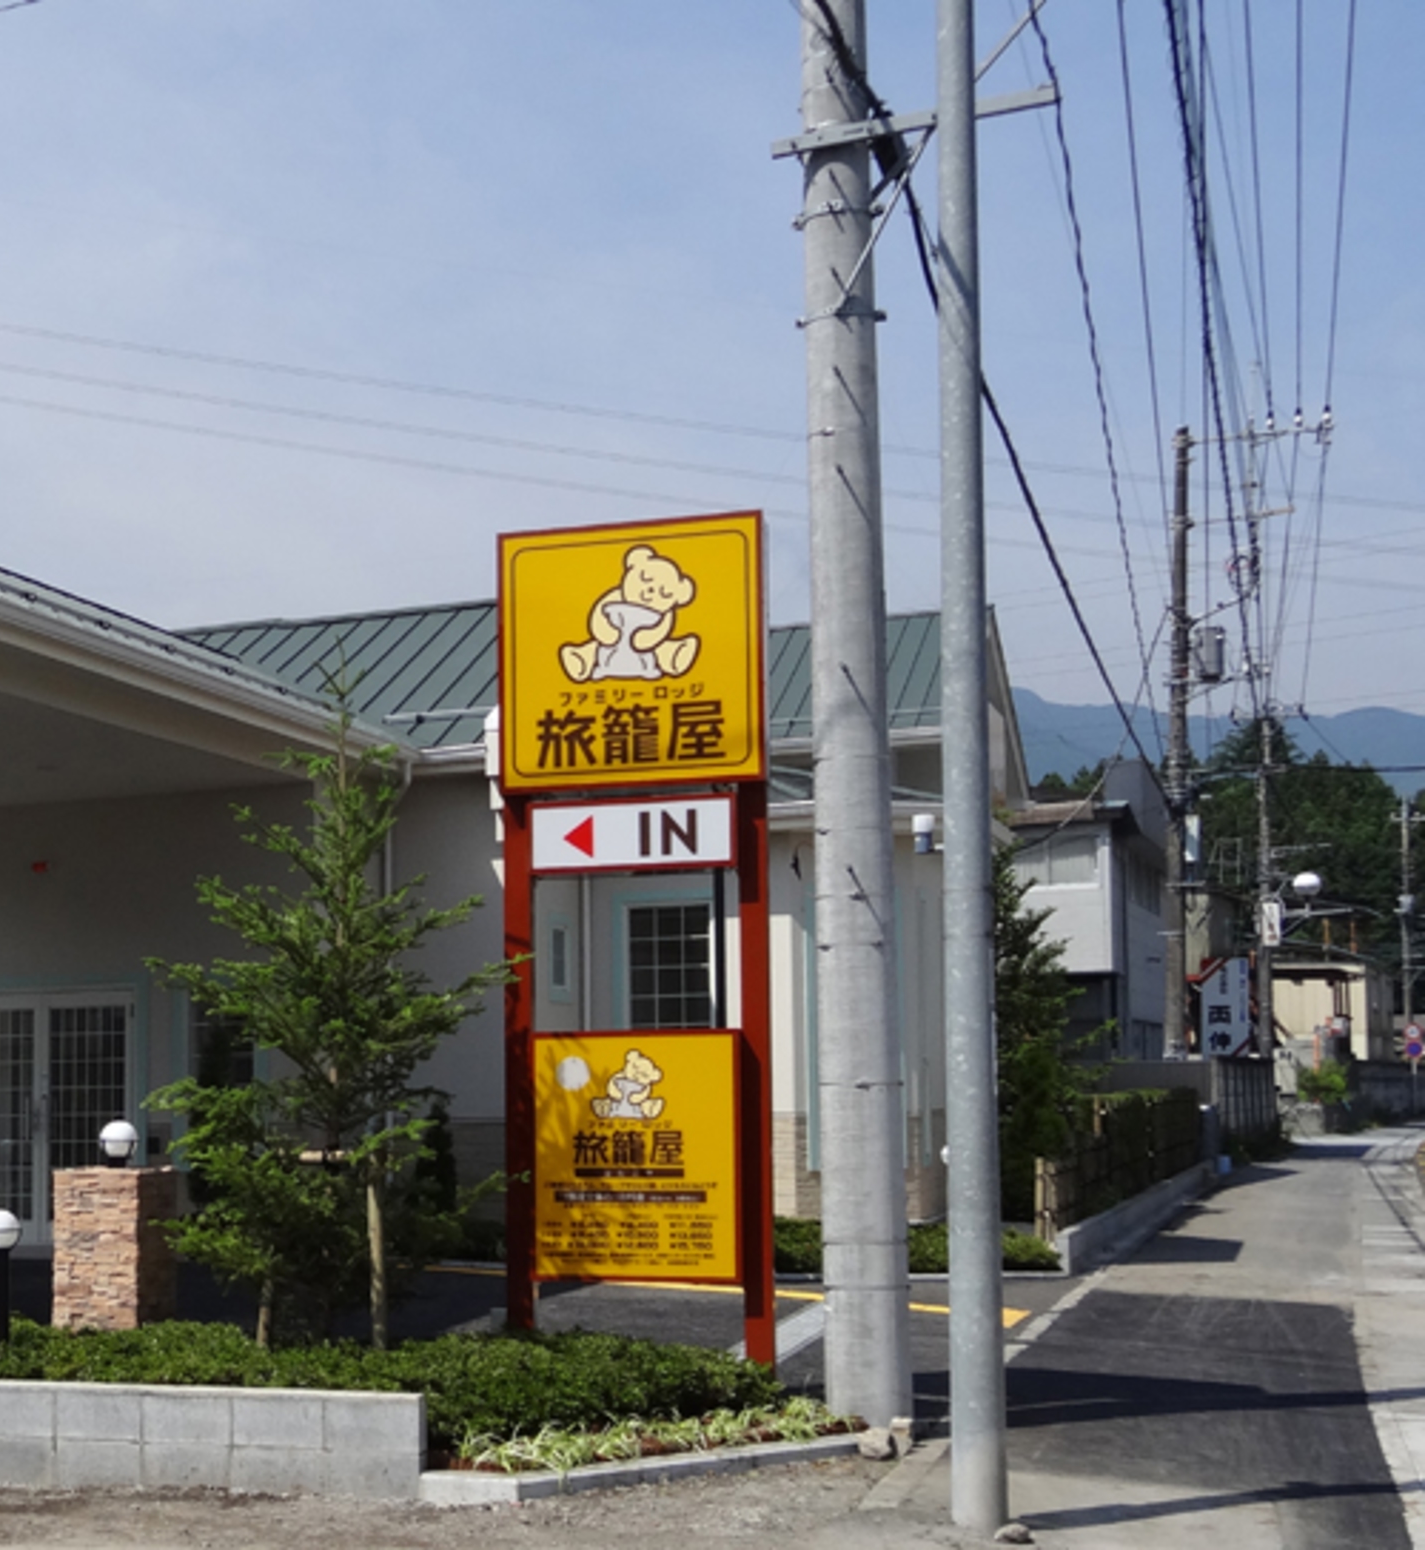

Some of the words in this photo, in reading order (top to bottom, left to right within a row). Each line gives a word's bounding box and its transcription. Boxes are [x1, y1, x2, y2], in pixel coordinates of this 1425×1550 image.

[559, 688, 644, 707] ファミリー
[653, 682, 705, 700] ロッジ
[536, 700, 726, 769] 旅籠屋
[638, 808, 698, 857] IN
[572, 1130, 685, 1166] 旅籠屋
